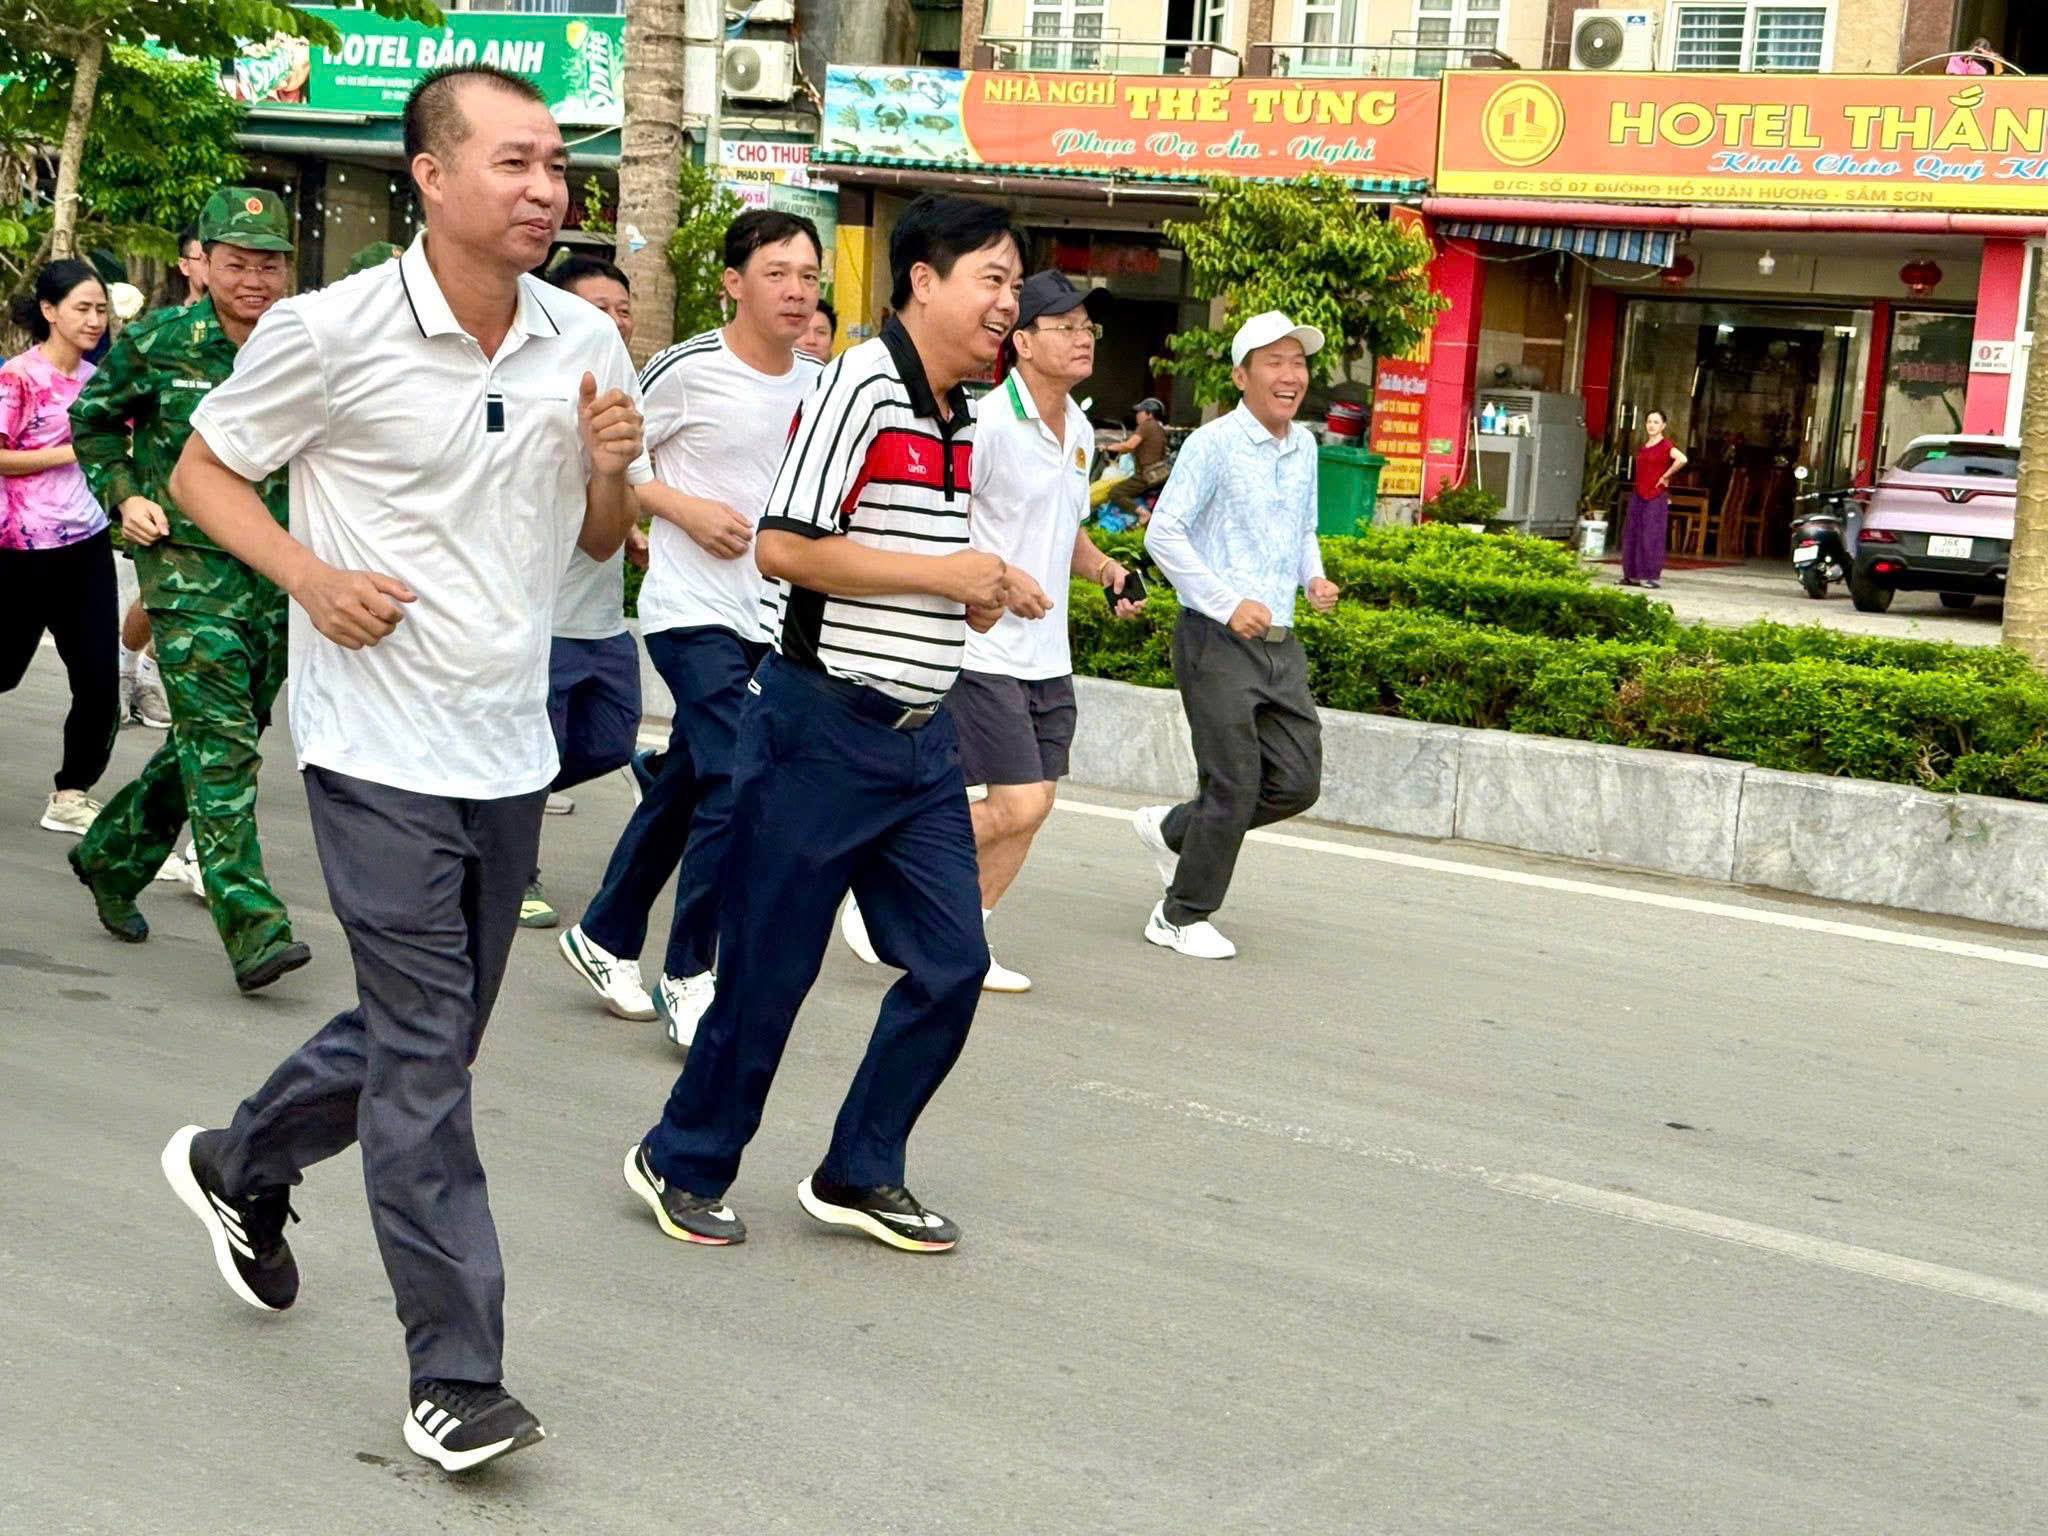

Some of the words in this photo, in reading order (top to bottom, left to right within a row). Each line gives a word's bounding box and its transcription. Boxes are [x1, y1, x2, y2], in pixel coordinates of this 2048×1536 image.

[416, 27, 477, 69] BẢO
[481, 39, 546, 74] ANH
[985, 75, 1042, 102] NHÀ
[1125, 77, 1233, 121] THẾ
[1247, 82, 1397, 125] TÙNG
[1608, 101, 1823, 149] HOTEL
[1843, 84, 2046, 152] THẮN
[737, 144, 767, 163] CHO
[1052, 127, 1137, 158] Phục
[1145, 131, 1198, 160] Vụ
[1539, 177, 1563, 192] SỐ
[1700, 183, 1752, 198] XUÂN
[1759, 185, 1829, 200] HƯƠNG
[1893, 190, 1934, 202] SƠN
